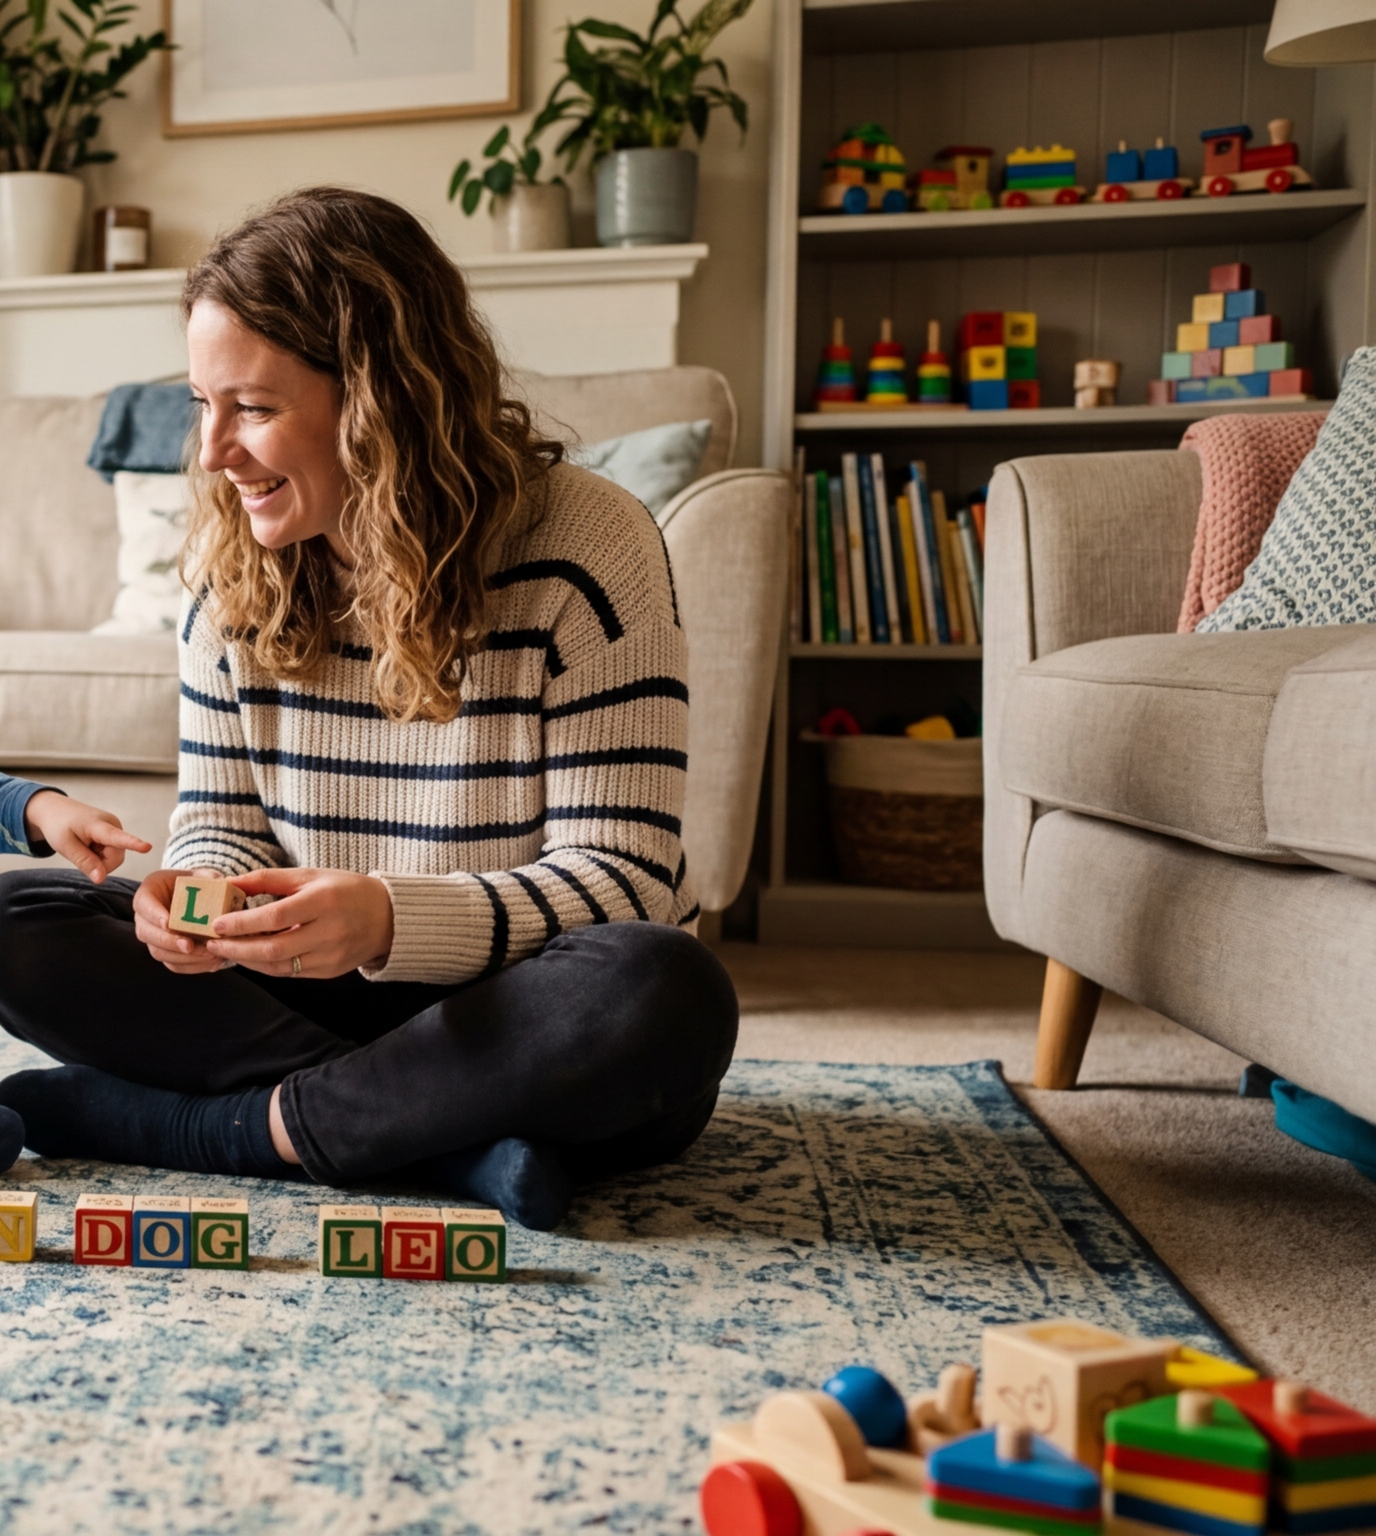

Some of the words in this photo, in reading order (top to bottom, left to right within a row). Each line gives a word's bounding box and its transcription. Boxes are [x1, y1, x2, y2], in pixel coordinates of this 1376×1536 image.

[181, 886, 209, 925] L
[83, 1219, 240, 1260] DOG
[336, 1230, 496, 1271] LEO
